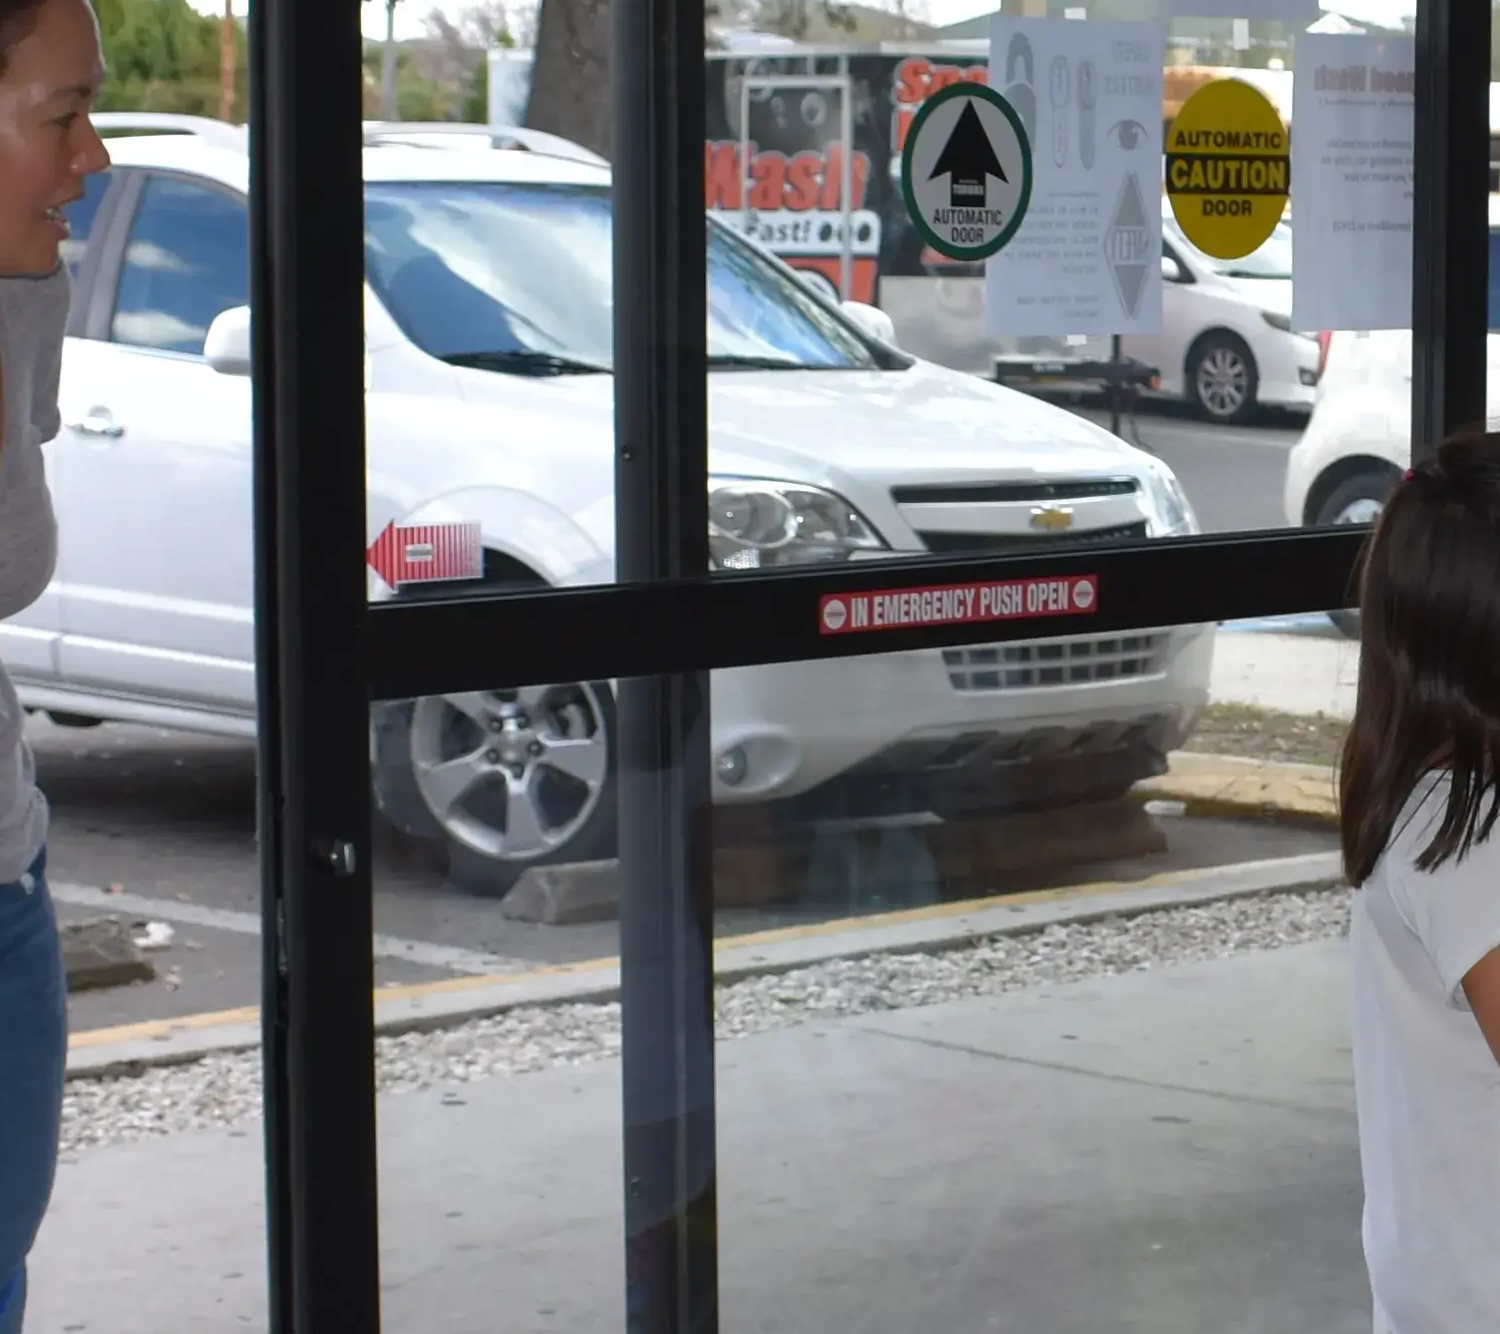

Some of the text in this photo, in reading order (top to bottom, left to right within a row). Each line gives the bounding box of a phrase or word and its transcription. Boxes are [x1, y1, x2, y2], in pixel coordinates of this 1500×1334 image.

[1174, 130, 1281, 149] AUTOMATIC
[1170, 159, 1286, 190] CAUTION
[932, 208, 1003, 226] AUTOMATIC
[1202, 199, 1253, 217] DOOR
[951, 226, 985, 243] DOOR
[851, 597, 868, 628] IN
[873, 588, 976, 626] EMERGENCY
[980, 581, 1023, 617] PUSH
[1026, 581, 1070, 613] OPEN
